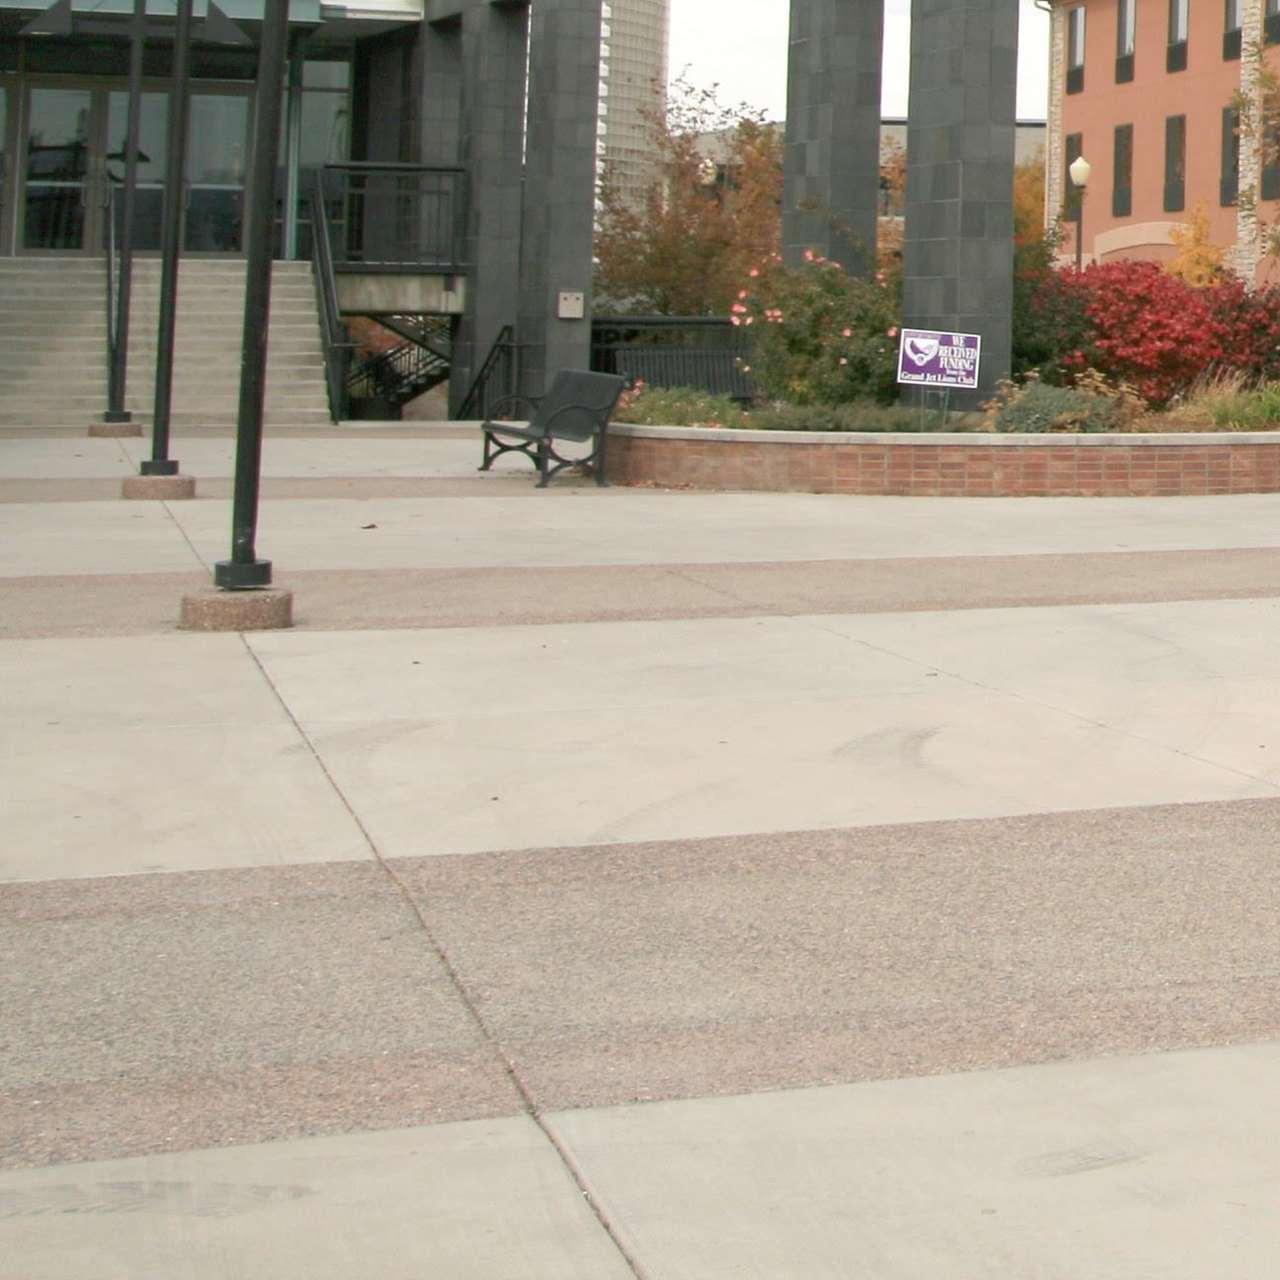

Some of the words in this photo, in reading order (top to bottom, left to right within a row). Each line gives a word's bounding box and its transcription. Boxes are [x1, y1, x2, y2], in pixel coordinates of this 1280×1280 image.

[952, 336, 966, 346] WE
[938, 346, 977, 359] RECEIVED
[939, 357, 974, 370] FUNDING
